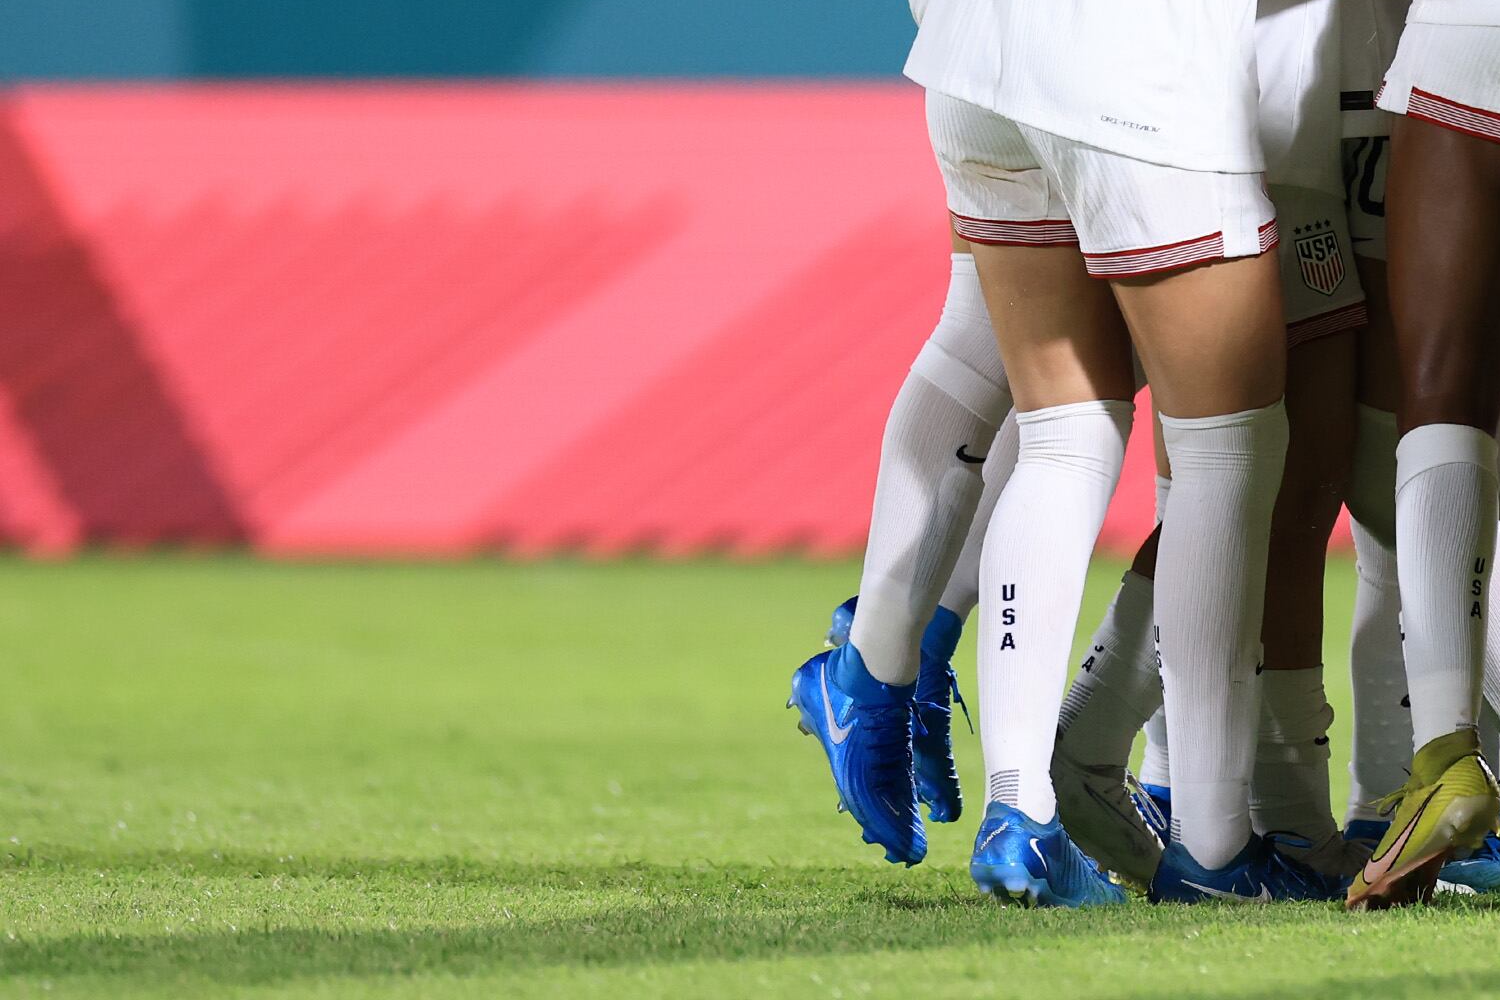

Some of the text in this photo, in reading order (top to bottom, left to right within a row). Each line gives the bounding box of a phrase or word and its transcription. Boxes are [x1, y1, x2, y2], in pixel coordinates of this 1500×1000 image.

[1300, 235, 1337, 262] USA
[1000, 584, 1015, 651] USA
[1471, 557, 1485, 619] USA
